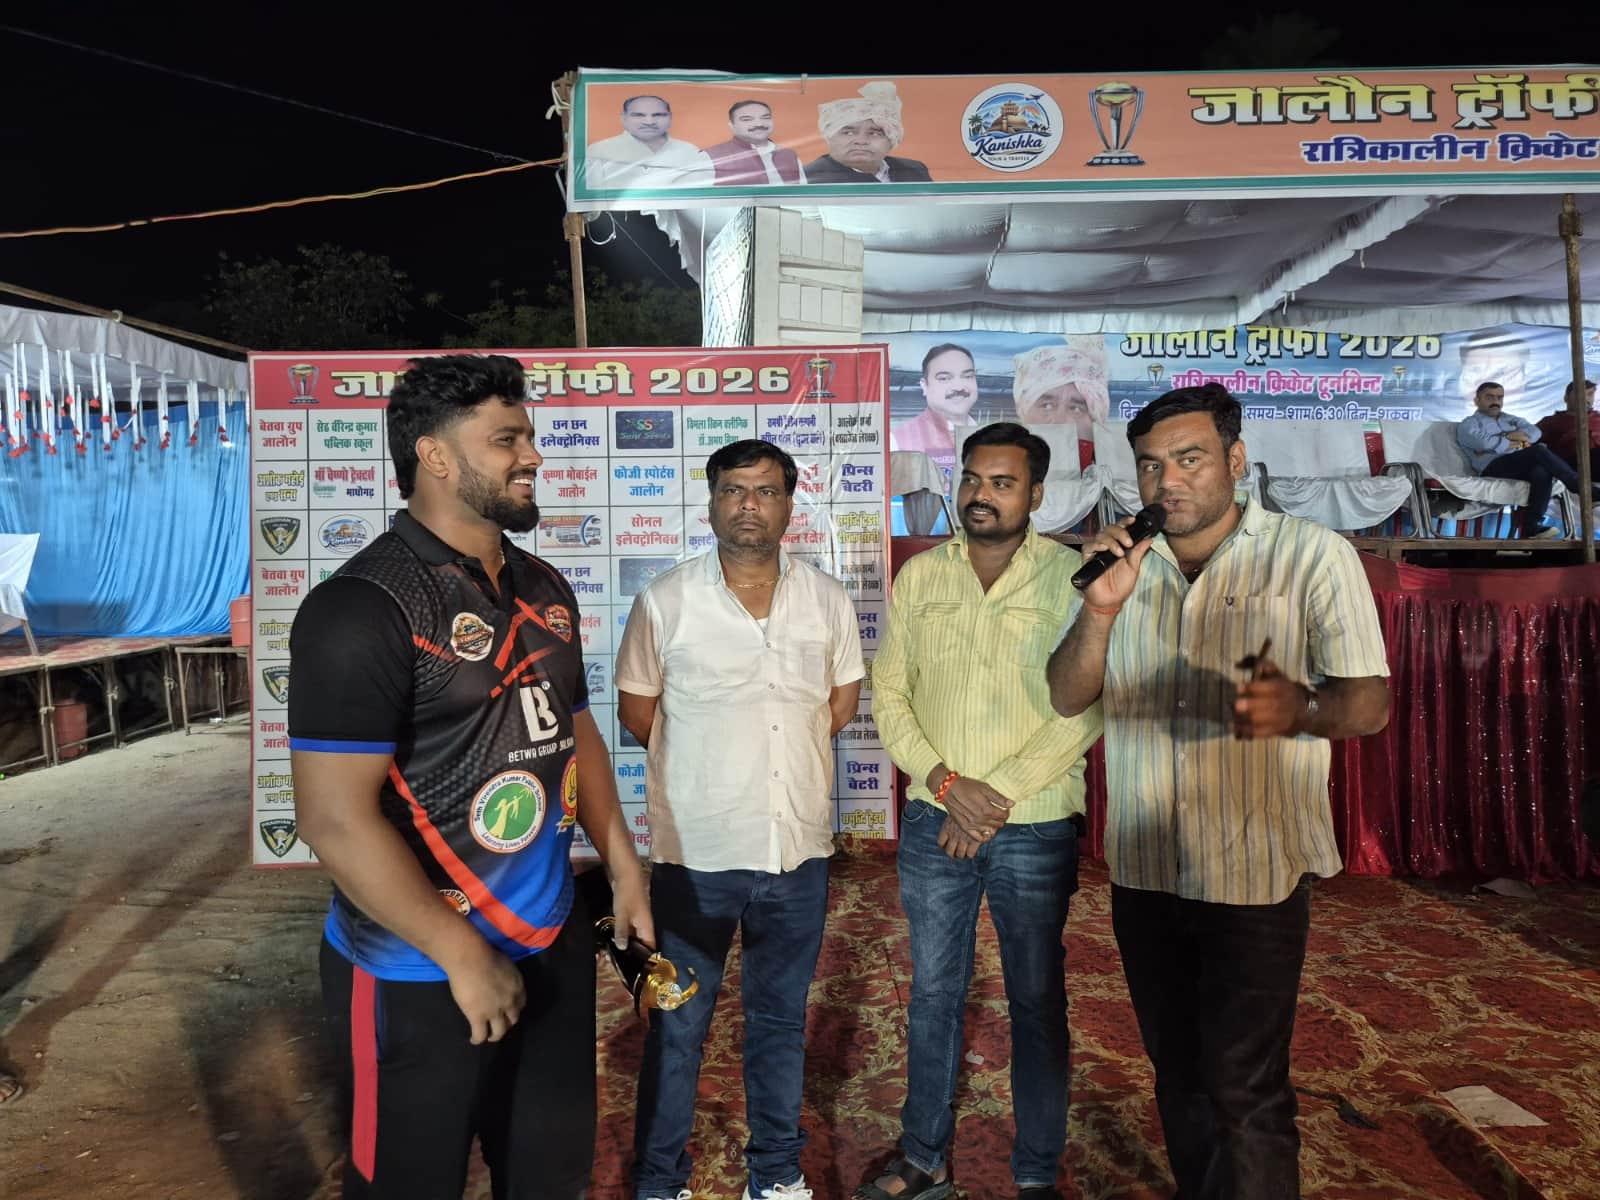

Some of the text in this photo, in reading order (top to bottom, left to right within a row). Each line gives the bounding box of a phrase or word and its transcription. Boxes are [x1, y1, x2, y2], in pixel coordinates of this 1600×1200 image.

[1189, 75, 1436, 125] जालौन
[971, 134, 1043, 156] Kanishka
[1302, 132, 1600, 163] रात्रिकालीन क्रिकेट
[525, 361, 790, 402] ट्रॉफी 2026
[1266, 369, 1314, 395] क्रिकेट
[508, 746, 537, 763] BETWA
[538, 742, 557, 757] GROUP
